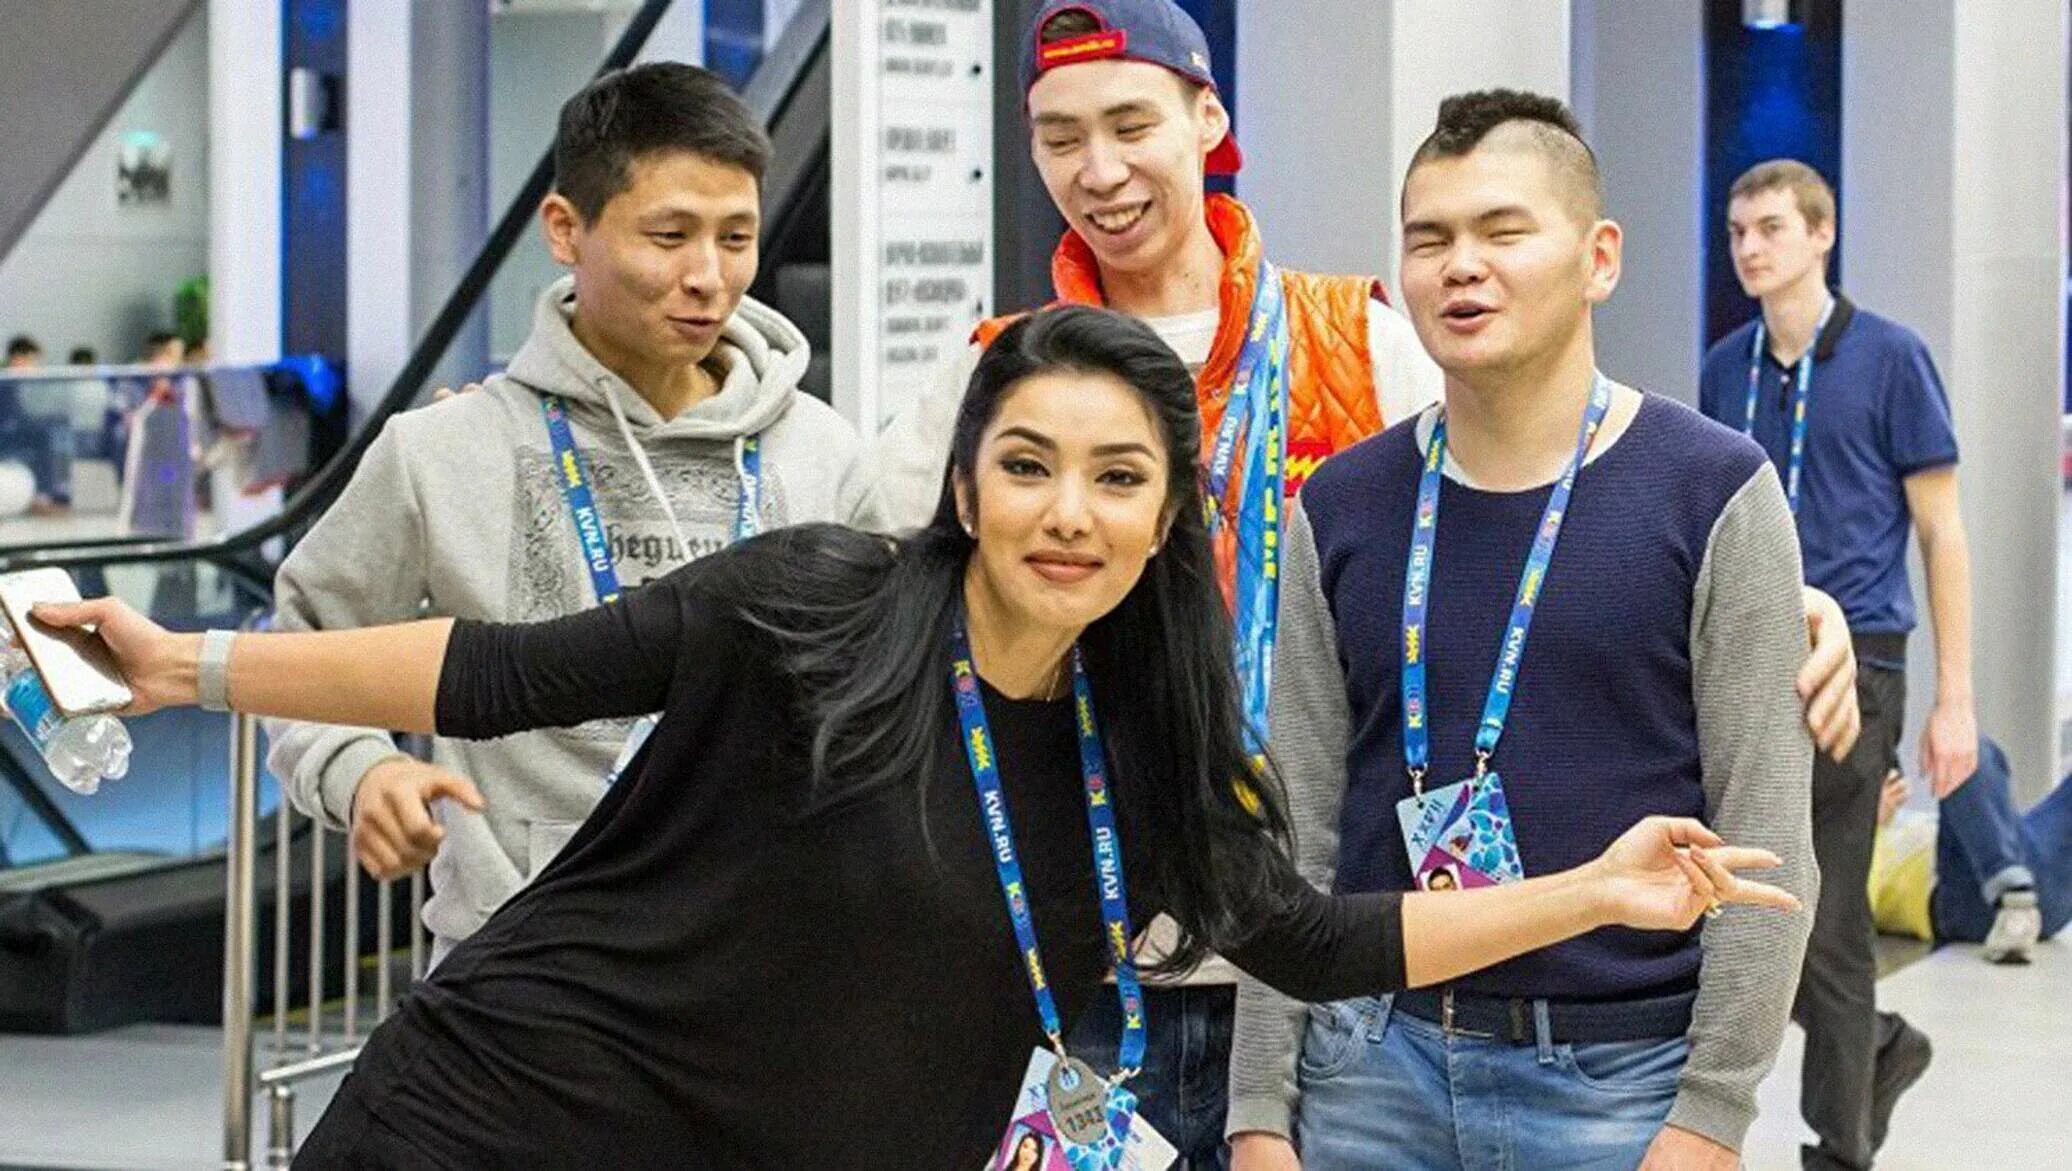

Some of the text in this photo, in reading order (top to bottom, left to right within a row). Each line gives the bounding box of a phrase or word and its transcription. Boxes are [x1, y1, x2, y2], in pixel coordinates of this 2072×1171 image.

[576, 507, 609, 572] KVN.RU
[1408, 545, 1428, 605] KVN.RU
[1496, 626, 1525, 694] KVN.RU
[984, 790, 1012, 863] KVN.RU
[1096, 827, 1119, 899] KVN.RU
